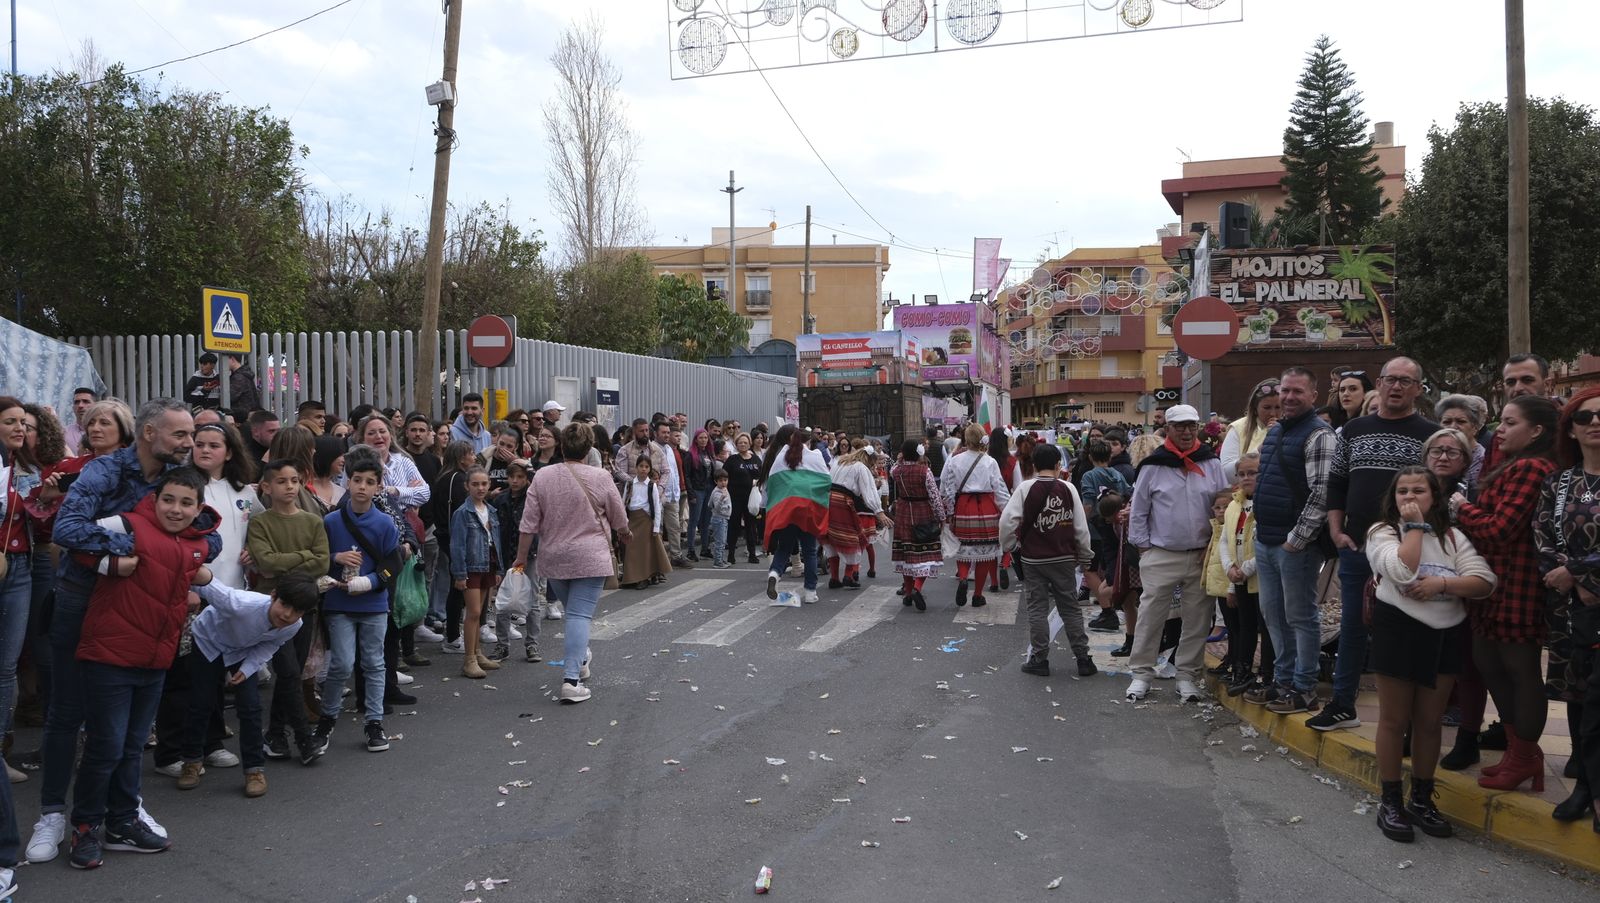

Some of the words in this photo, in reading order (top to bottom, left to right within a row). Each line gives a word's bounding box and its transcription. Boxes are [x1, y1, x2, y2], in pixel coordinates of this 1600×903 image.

[1230, 255, 1325, 278] MOJITOS
[1219, 282, 1245, 303] EL
[1255, 278, 1366, 303] PALMERAL
[1042, 495, 1063, 513] Los
[1033, 507, 1074, 533] Angeles
